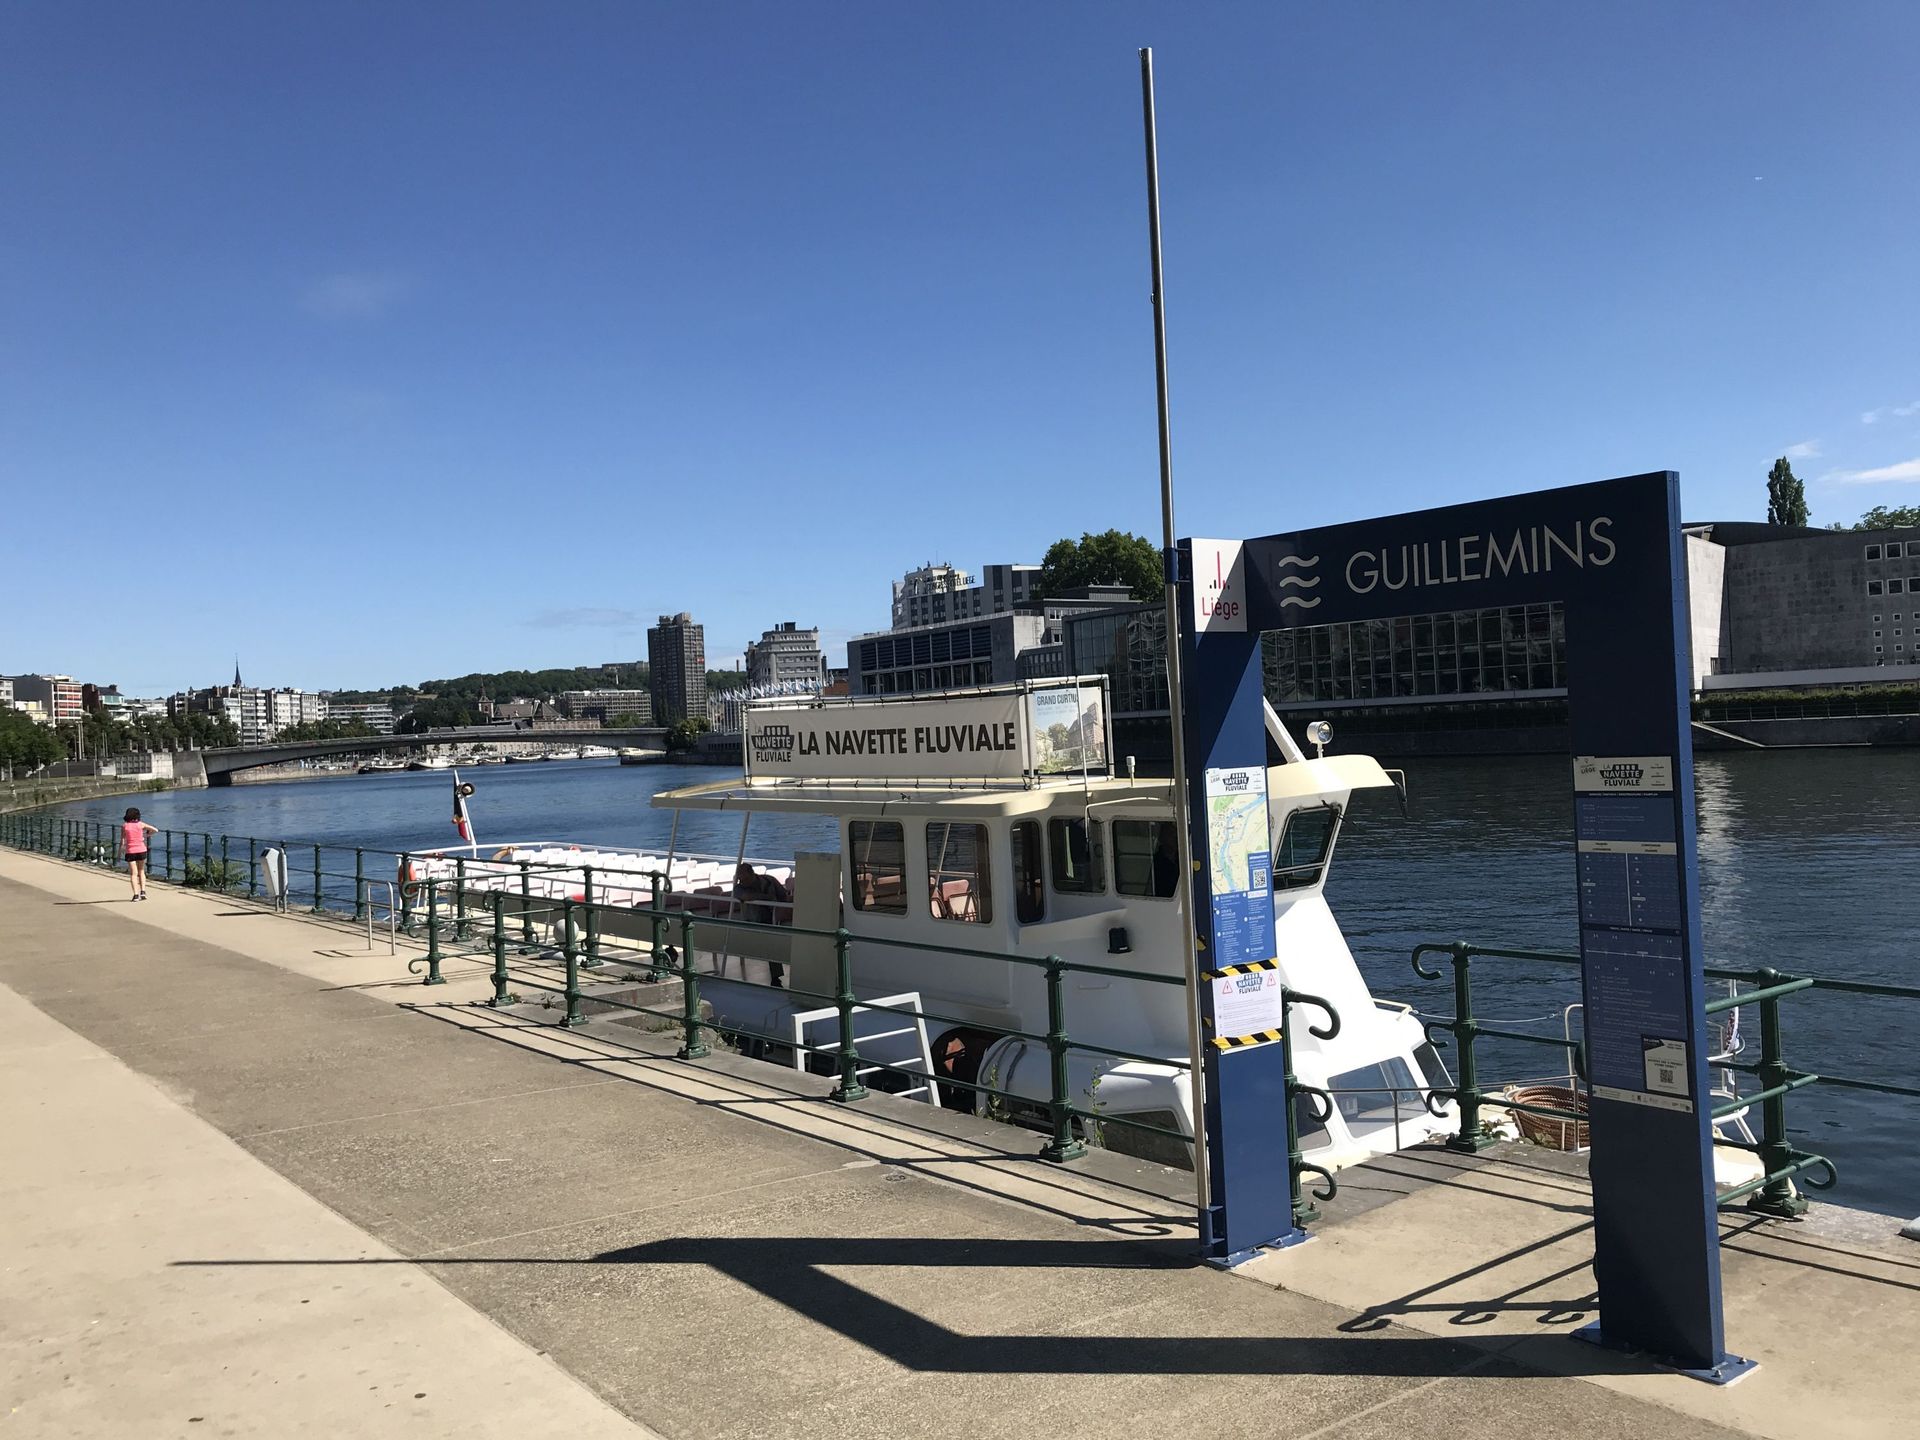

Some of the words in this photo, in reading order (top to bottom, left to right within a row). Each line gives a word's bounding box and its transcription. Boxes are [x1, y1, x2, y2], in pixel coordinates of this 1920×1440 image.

[1345, 516, 1617, 595] GUILLEMINS
[1202, 597, 1239, 620] Liège
[1037, 694, 1056, 706] GRAND
[755, 736, 791, 748] NAVETTE
[798, 731, 820, 755] LA
[825, 728, 908, 755] NAVETTE
[914, 722, 1016, 753] FLUVIALE
[756, 751, 792, 762] FLUVIALE
[1603, 770, 1640, 778] NAVETTE
